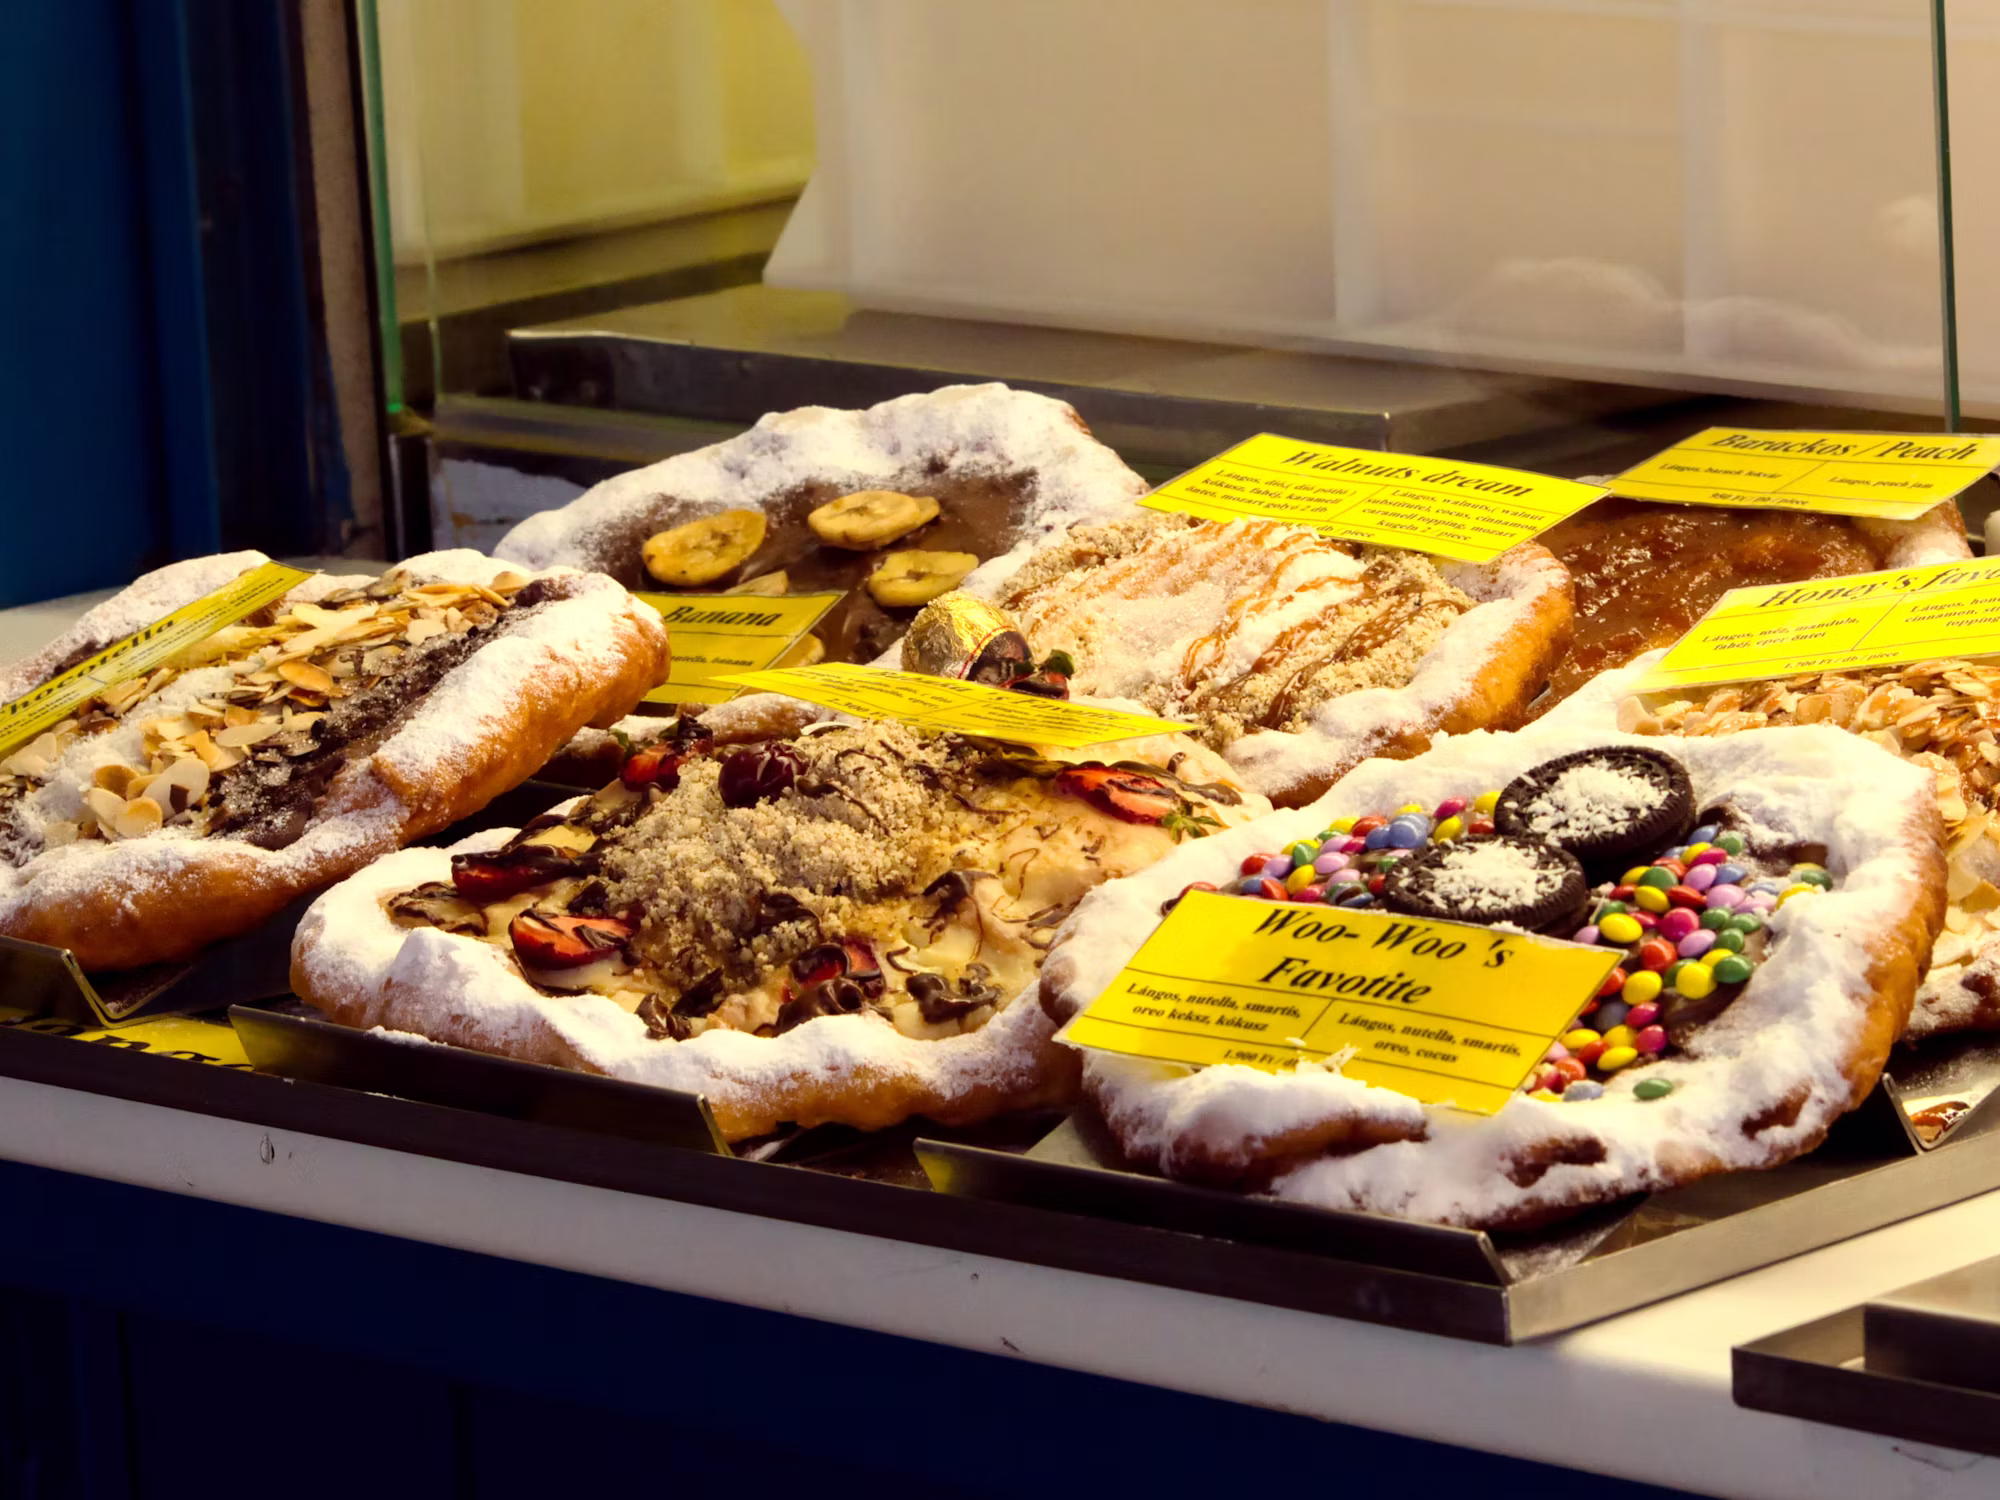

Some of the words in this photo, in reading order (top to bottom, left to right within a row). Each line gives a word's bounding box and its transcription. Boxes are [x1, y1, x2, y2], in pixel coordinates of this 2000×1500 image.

[1707, 434, 1857, 456] Barackos
[1852, 440, 1890, 457] /
[1875, 441, 1978, 460] Peach
[1216, 470, 1260, 484] Lángos,
[1281, 451, 1420, 479] Walnuts
[1421, 470, 1533, 497] dream
[1872, 480, 1909, 488] peach
[1221, 494, 1266, 506] mozart
[1286, 493, 1343, 504] karamell
[1392, 489, 1436, 502] Lángos,
[1501, 509, 1545, 521] walnut
[1362, 508, 1418, 520] caramell
[1417, 514, 1466, 530] topping,
[1470, 526, 1517, 539] mozart
[1377, 519, 1418, 532] kugeln
[1437, 531, 1471, 541] piece
[1436, 508, 1471, 520] cocus,
[1475, 515, 1538, 532] cinnamon,
[1755, 574, 1918, 608] Honey's
[664, 606, 783, 626] Banana
[1795, 618, 1860, 631] mandula,
[1905, 609, 1977, 622] cinnamon,
[1756, 636, 1790, 646] eper
[0, 620, 173, 714] hocotella
[1867, 652, 1899, 661] piece
[1253, 909, 1360, 943] Woo-
[1371, 922, 1467, 959] Woo
[1482, 939, 1514, 968] 's
[1126, 982, 1182, 1003] Lángos,
[1186, 993, 1239, 1012] nutella,
[1243, 1001, 1301, 1018] smartis,
[1132, 1004, 1165, 1017] oreo
[1167, 1007, 1211, 1026] keksz,
[1215, 1012, 1269, 1031] kókusz
[1337, 1012, 1395, 1033] Lángos,
[1400, 1024, 1456, 1045] nutella,
[1460, 1035, 1521, 1057] smartis,
[1373, 1040, 1411, 1055] oreo,
[1416, 1047, 1458, 1063] cocus
